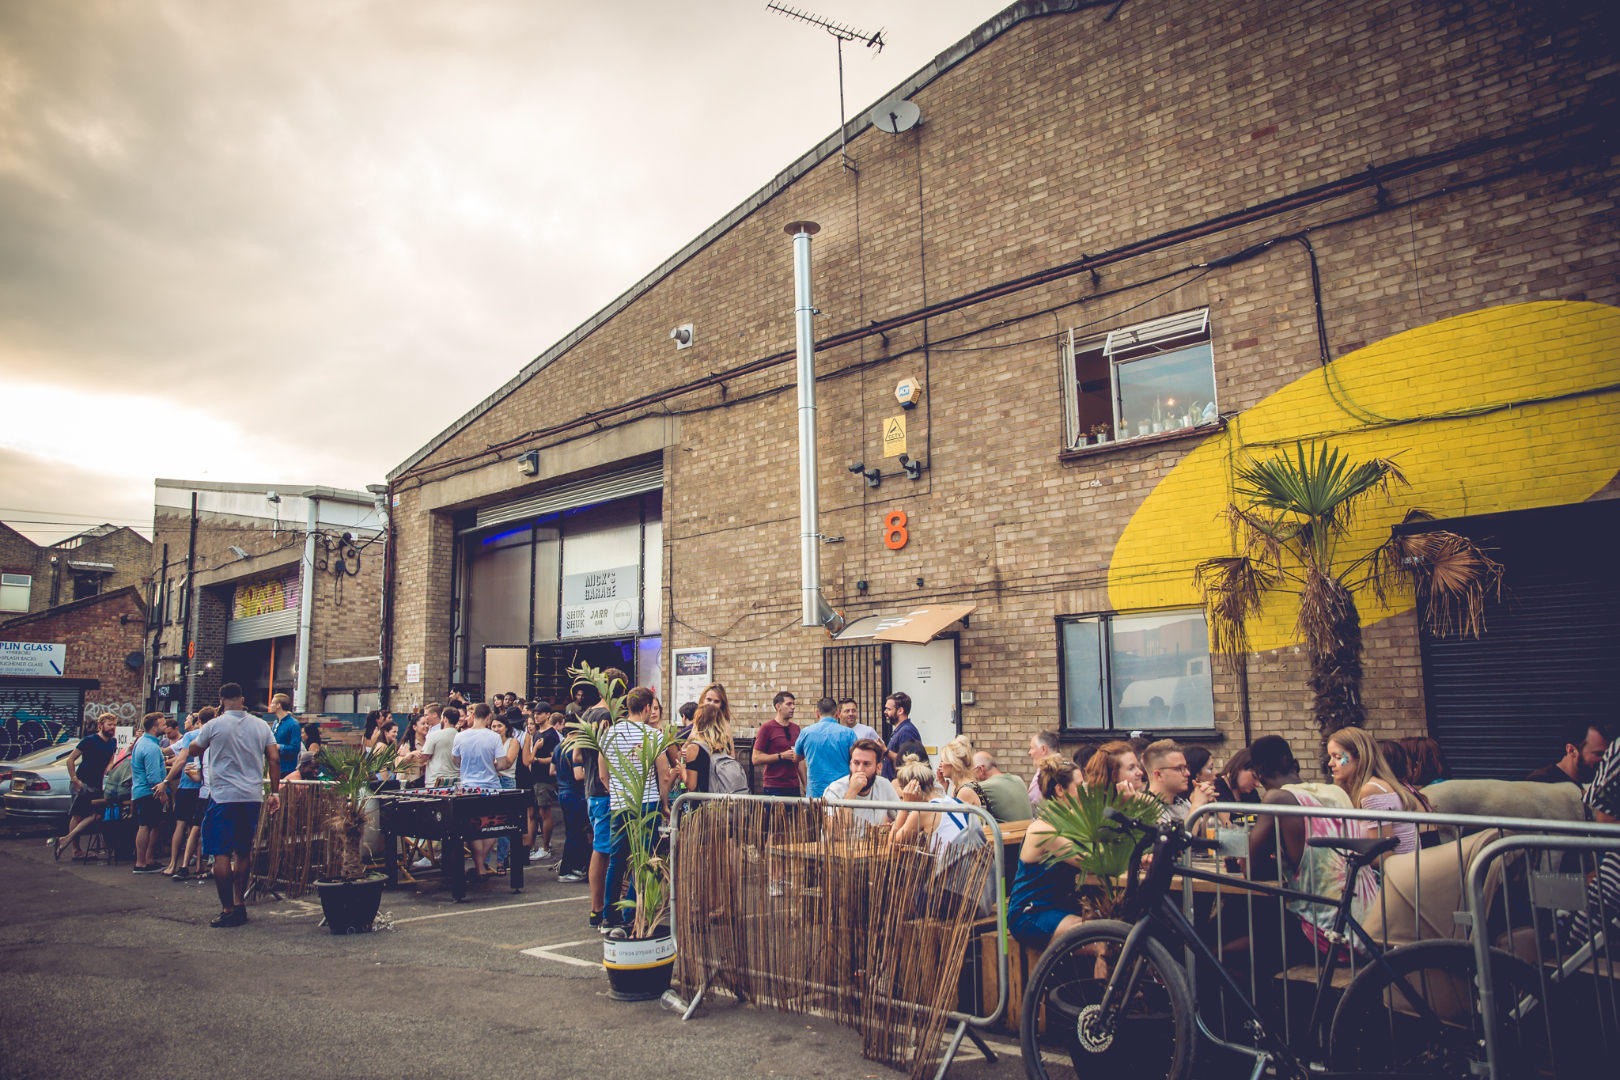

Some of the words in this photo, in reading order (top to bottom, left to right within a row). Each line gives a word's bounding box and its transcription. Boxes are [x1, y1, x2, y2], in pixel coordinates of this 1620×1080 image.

[899, 386, 909, 395] ADT
[884, 510, 908, 550] 8
[585, 571, 616, 588] MICK'S
[585, 585, 616, 601] GARAGE
[567, 609, 585, 620] SHUK
[590, 609, 608, 619] JARR
[567, 619, 585, 629] SHUK
[188, 641, 195, 659] 6
[118, 734, 128, 745] BOX
